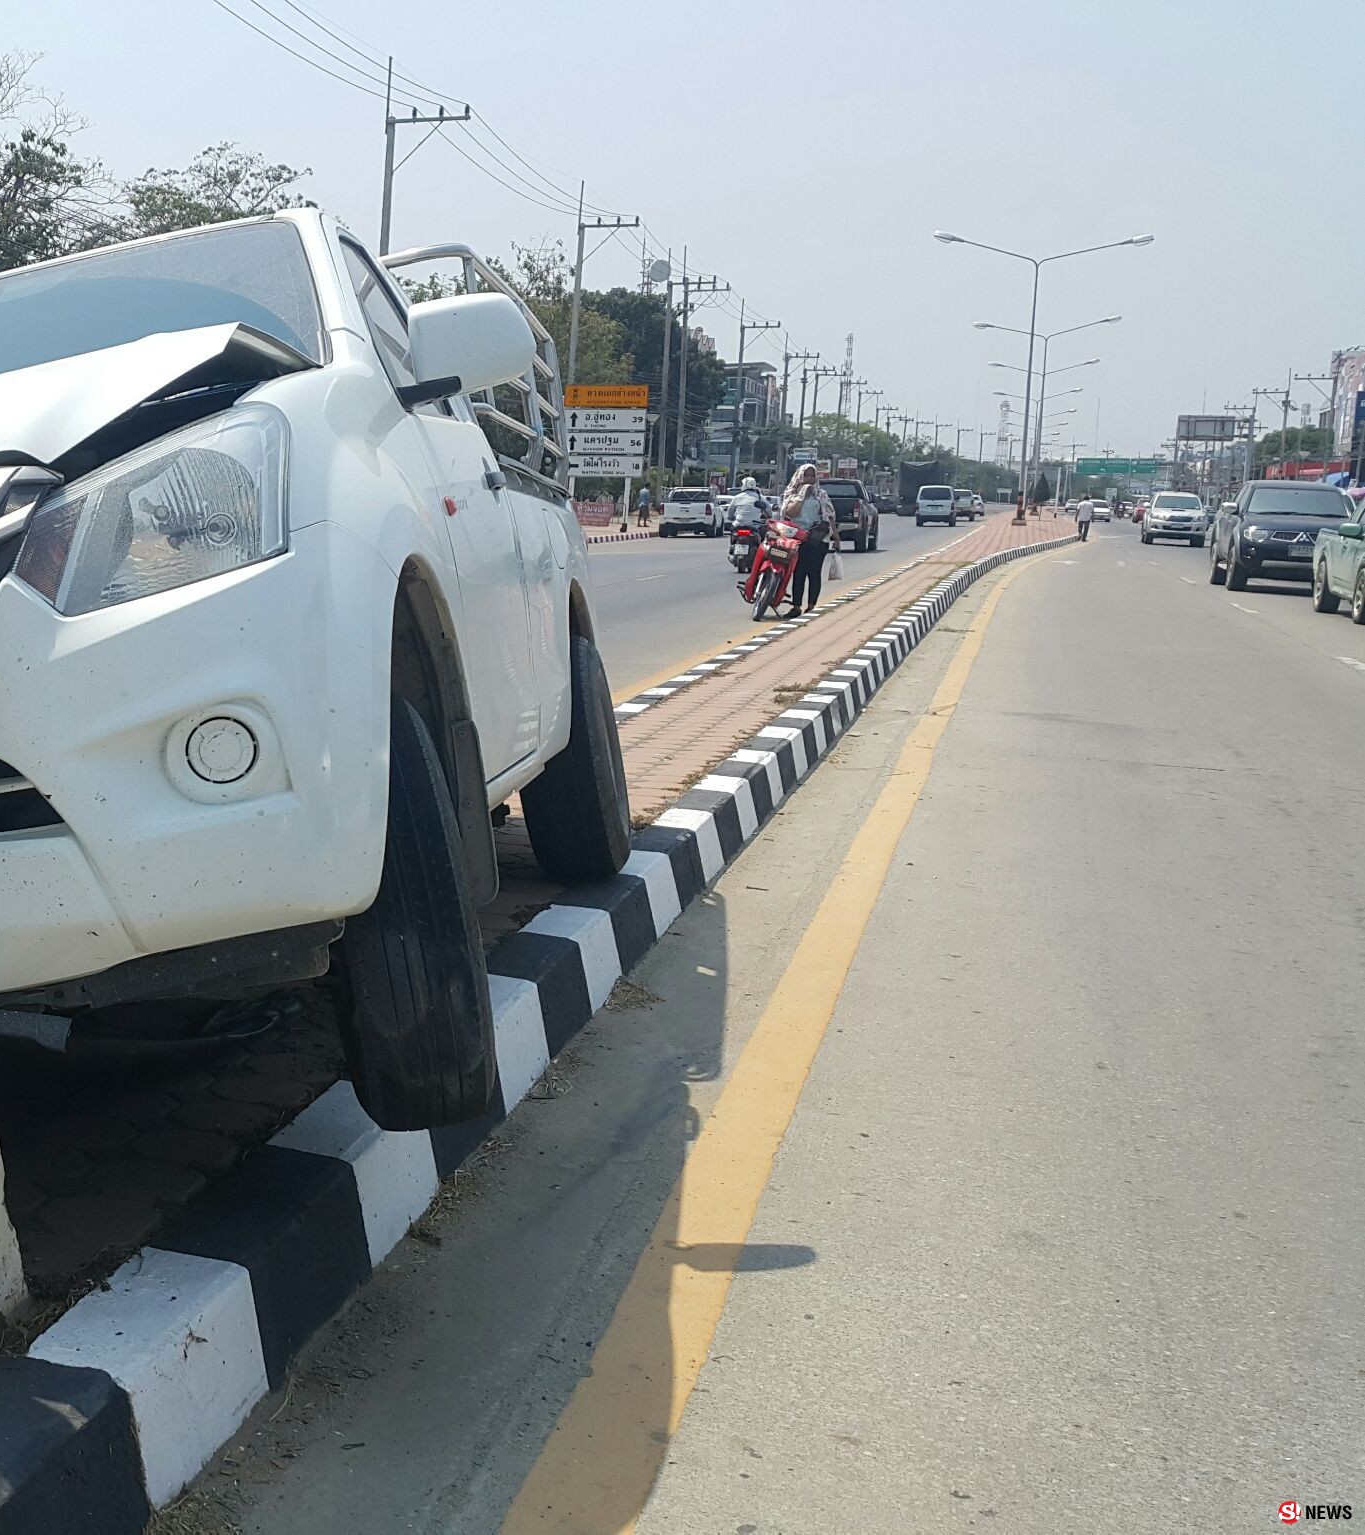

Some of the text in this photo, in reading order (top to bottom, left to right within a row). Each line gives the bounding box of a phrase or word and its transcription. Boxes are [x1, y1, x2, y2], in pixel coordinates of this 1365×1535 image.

[585, 411, 644, 424] อ.อู่ทอง 39
[584, 435, 642, 447] นครปฐม 56
